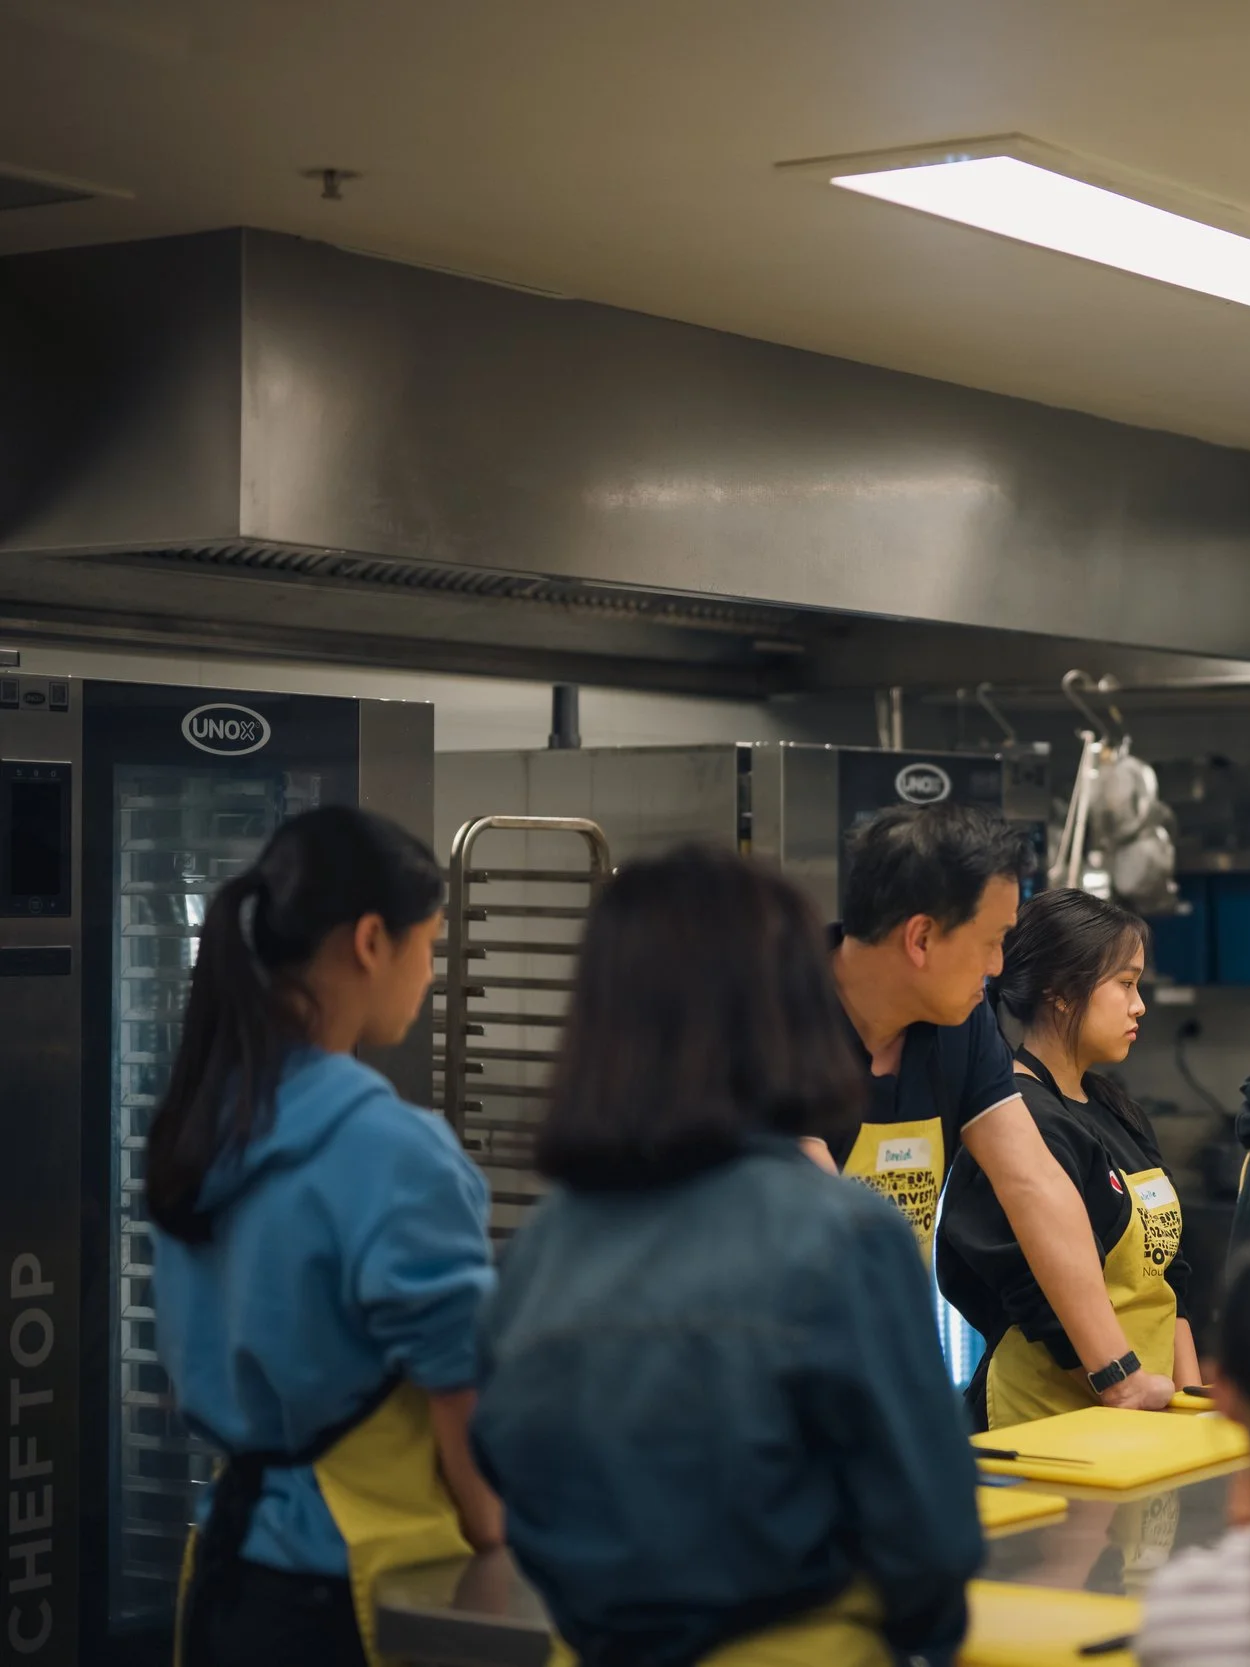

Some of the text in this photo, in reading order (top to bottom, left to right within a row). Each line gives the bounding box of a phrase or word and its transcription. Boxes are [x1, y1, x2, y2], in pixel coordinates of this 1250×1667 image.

[192, 717, 255, 741] UNOX
[883, 1189, 932, 1208] ARVEST
[8, 1252, 54, 1655] CHEFTOP
